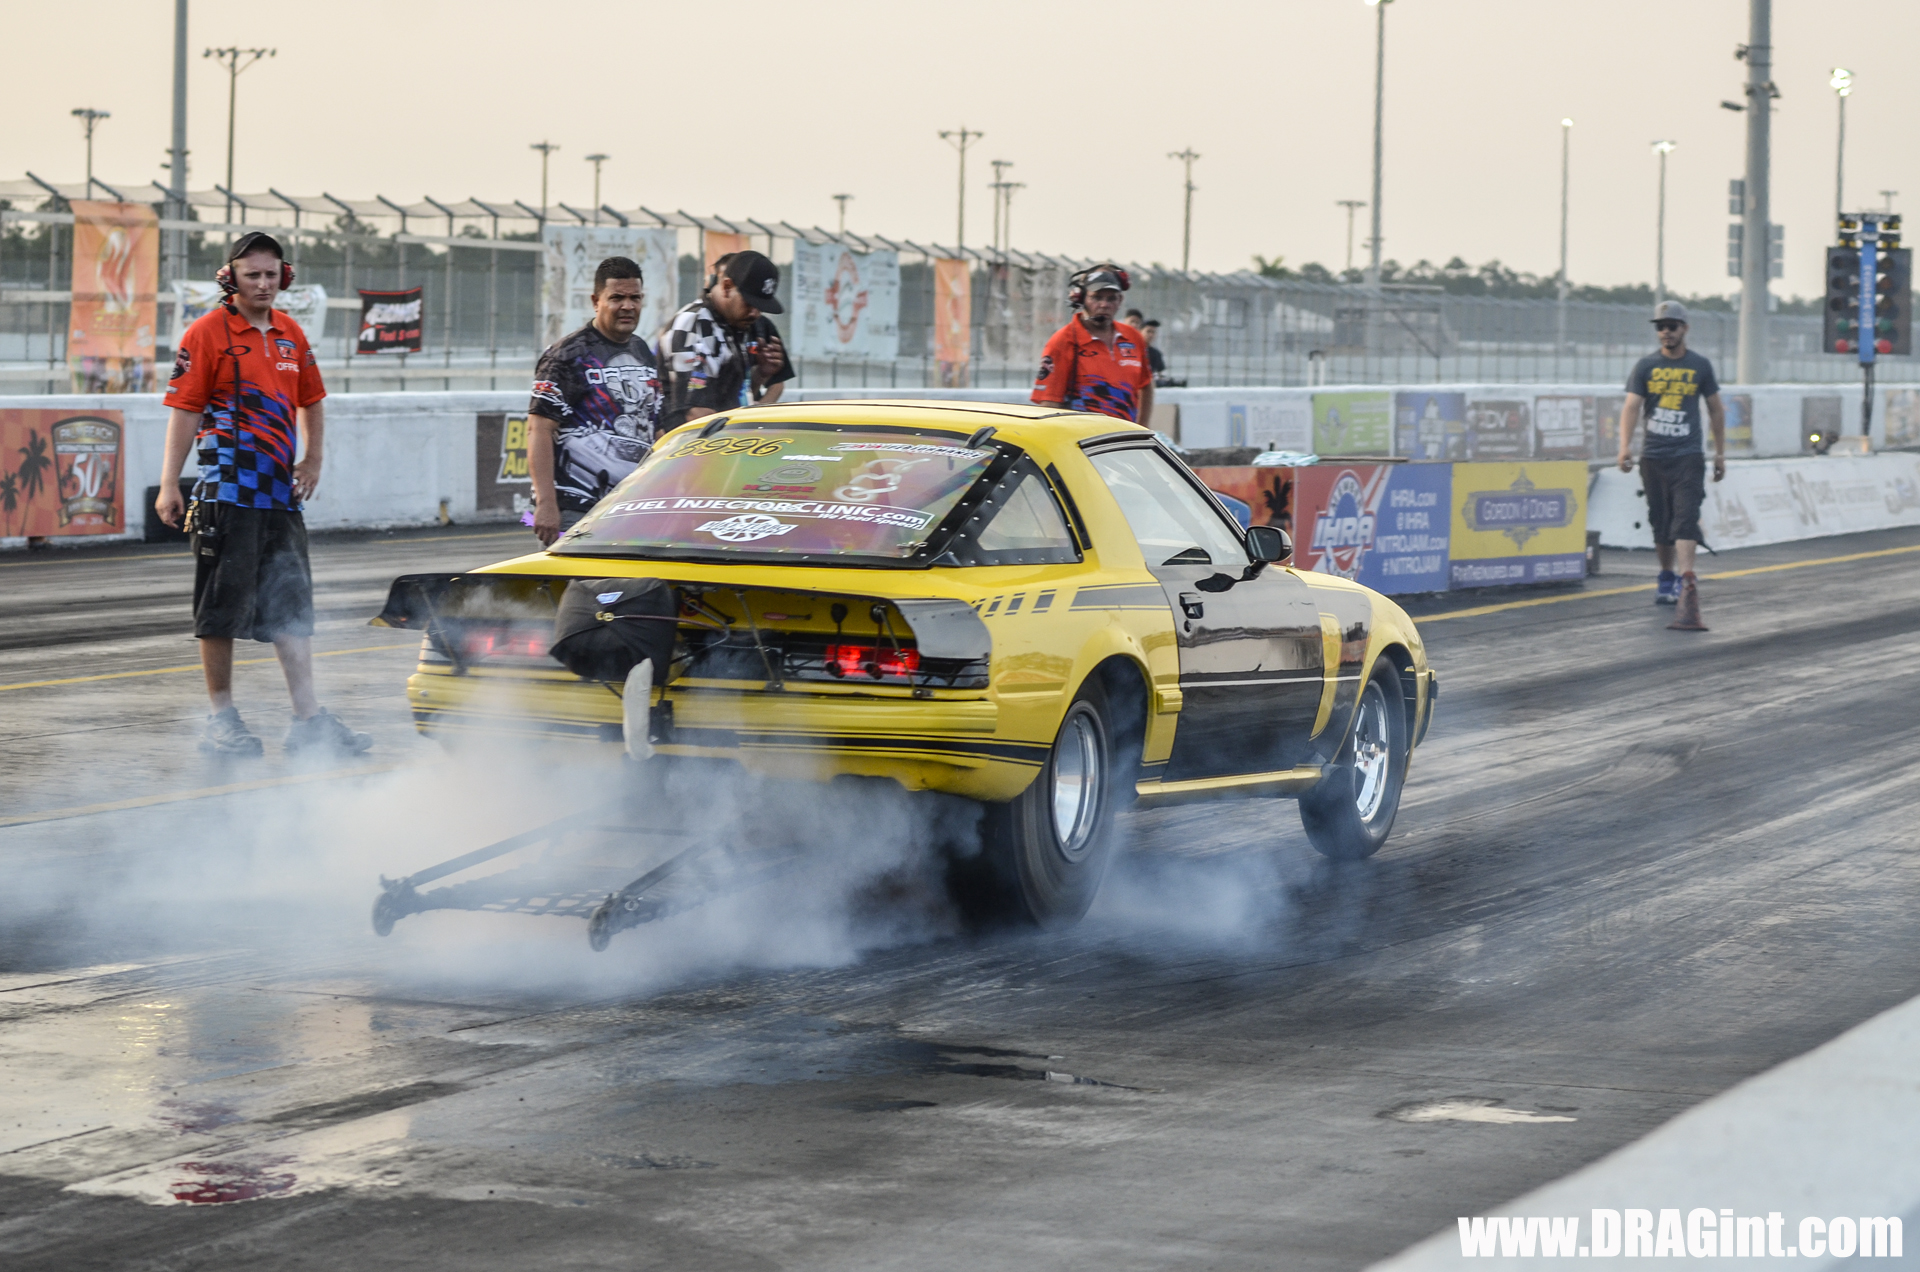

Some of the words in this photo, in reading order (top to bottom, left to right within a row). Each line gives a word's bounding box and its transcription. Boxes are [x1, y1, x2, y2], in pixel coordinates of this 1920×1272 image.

[1651, 367, 1696, 382] DON'T
[1646, 380, 1698, 396] BELIEVE
[1658, 394, 1683, 410] ME
[1652, 407, 1687, 423] JUST
[1647, 419, 1690, 437] WATCH
[608, 500, 667, 514] FUEL
[1312, 515, 1375, 549] IHRA
